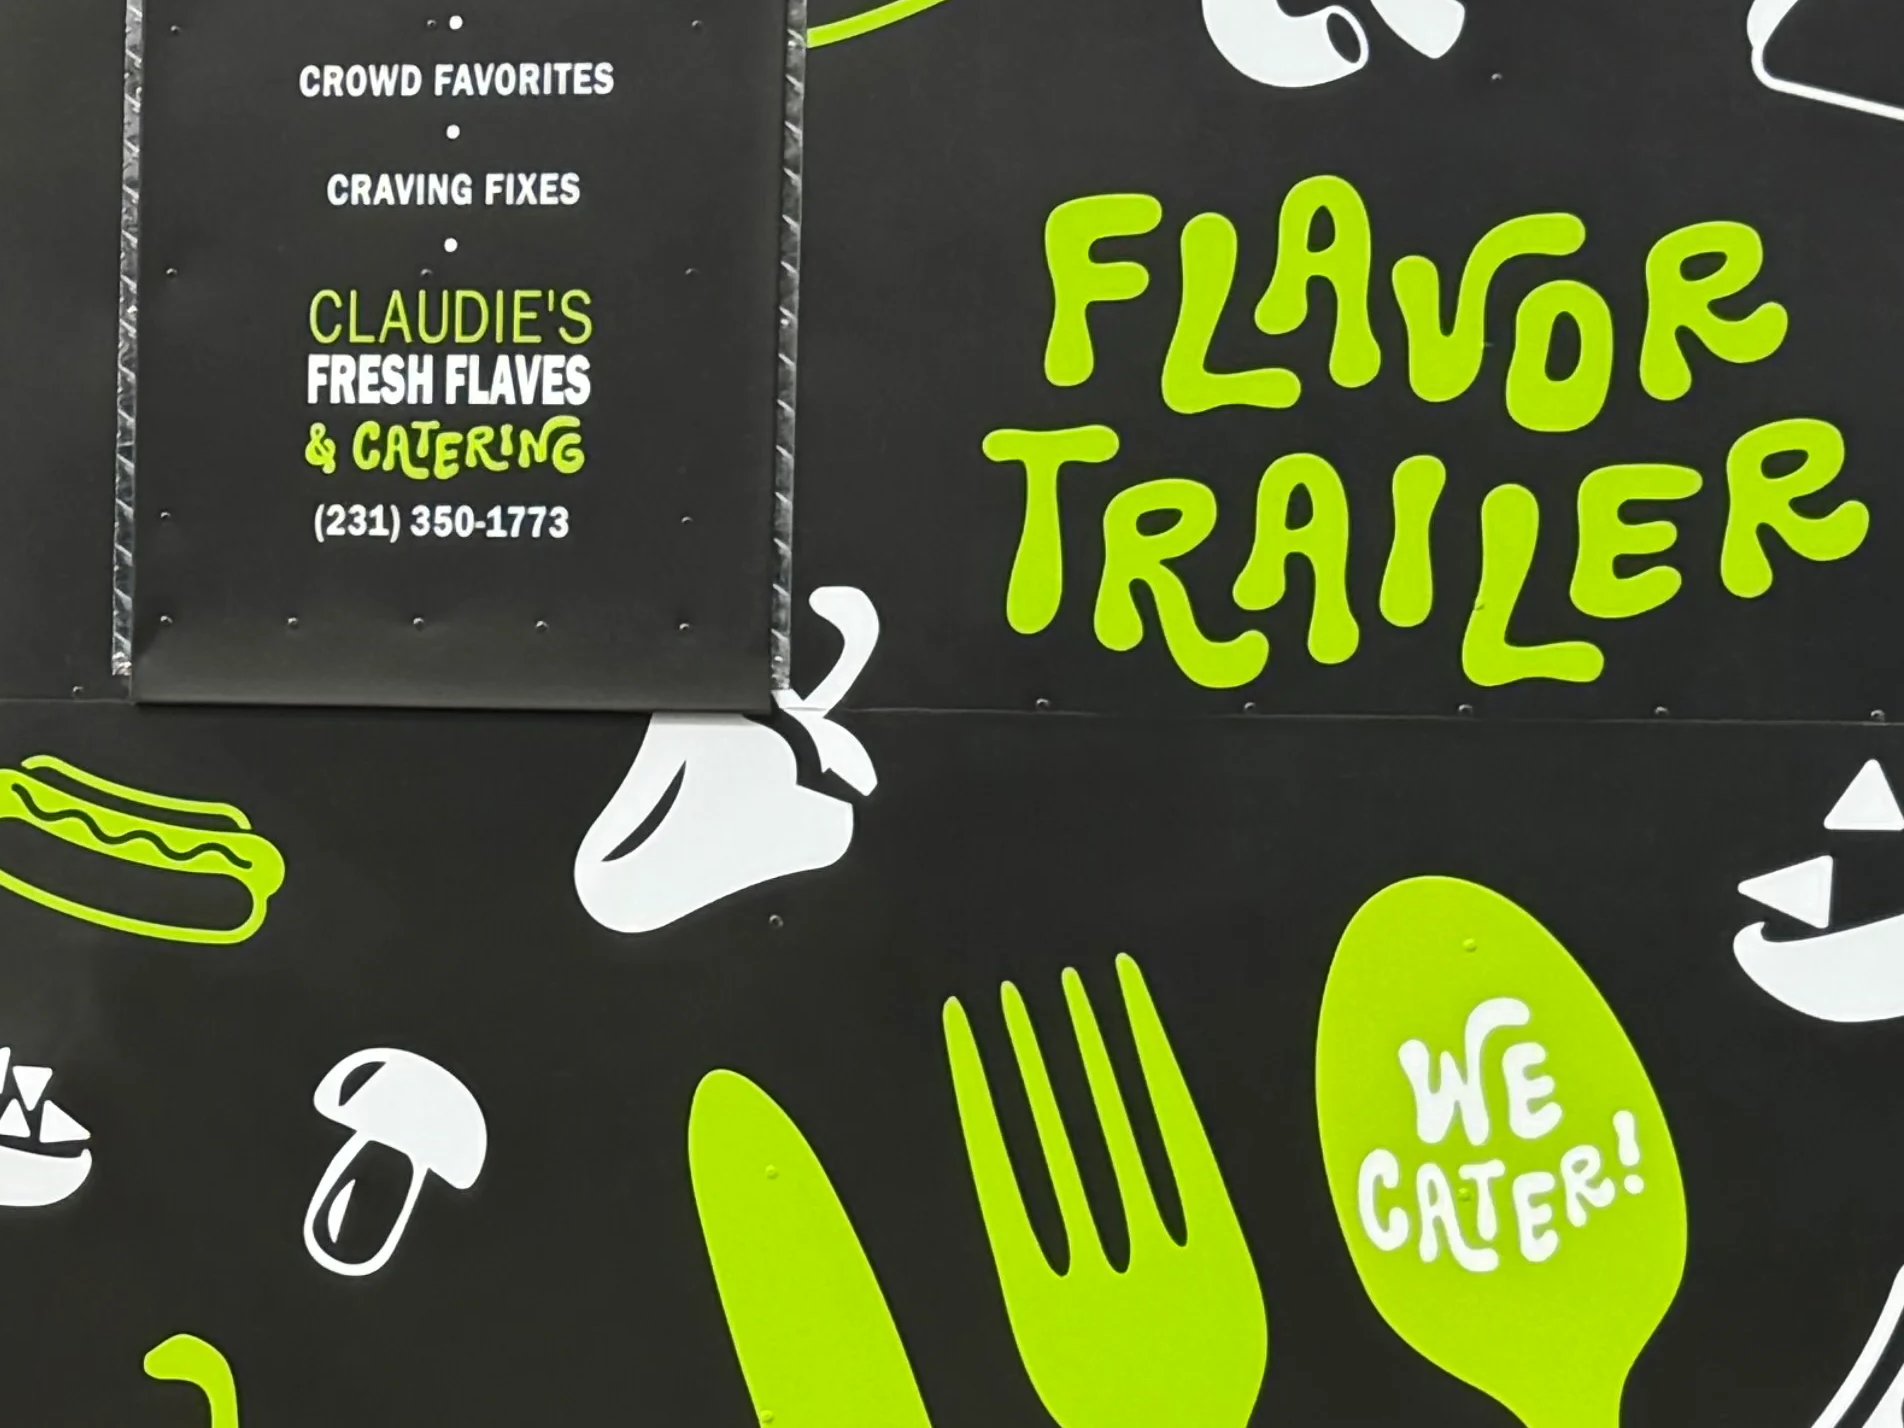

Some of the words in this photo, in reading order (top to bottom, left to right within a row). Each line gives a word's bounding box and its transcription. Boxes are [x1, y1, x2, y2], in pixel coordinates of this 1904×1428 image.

[300, 64, 422, 97] CROWD
[435, 62, 614, 96] FAVORITES
[328, 173, 472, 205] CRAVING
[486, 173, 580, 205] FIXES
[309, 289, 593, 345] CLAUDIE'S
[1044, 175, 1788, 432] FLAVOR
[308, 354, 433, 404] FRESH
[446, 355, 590, 405] FLAVES
[306, 428, 336, 473] &
[355, 418, 585, 479] CATERING
[315, 504, 400, 543] (231)
[411, 505, 568, 538] 350-1773
[983, 418, 1869, 688] TRAILER
[1398, 997, 1563, 1145] WE
[1358, 1110, 1645, 1273] CATER!
